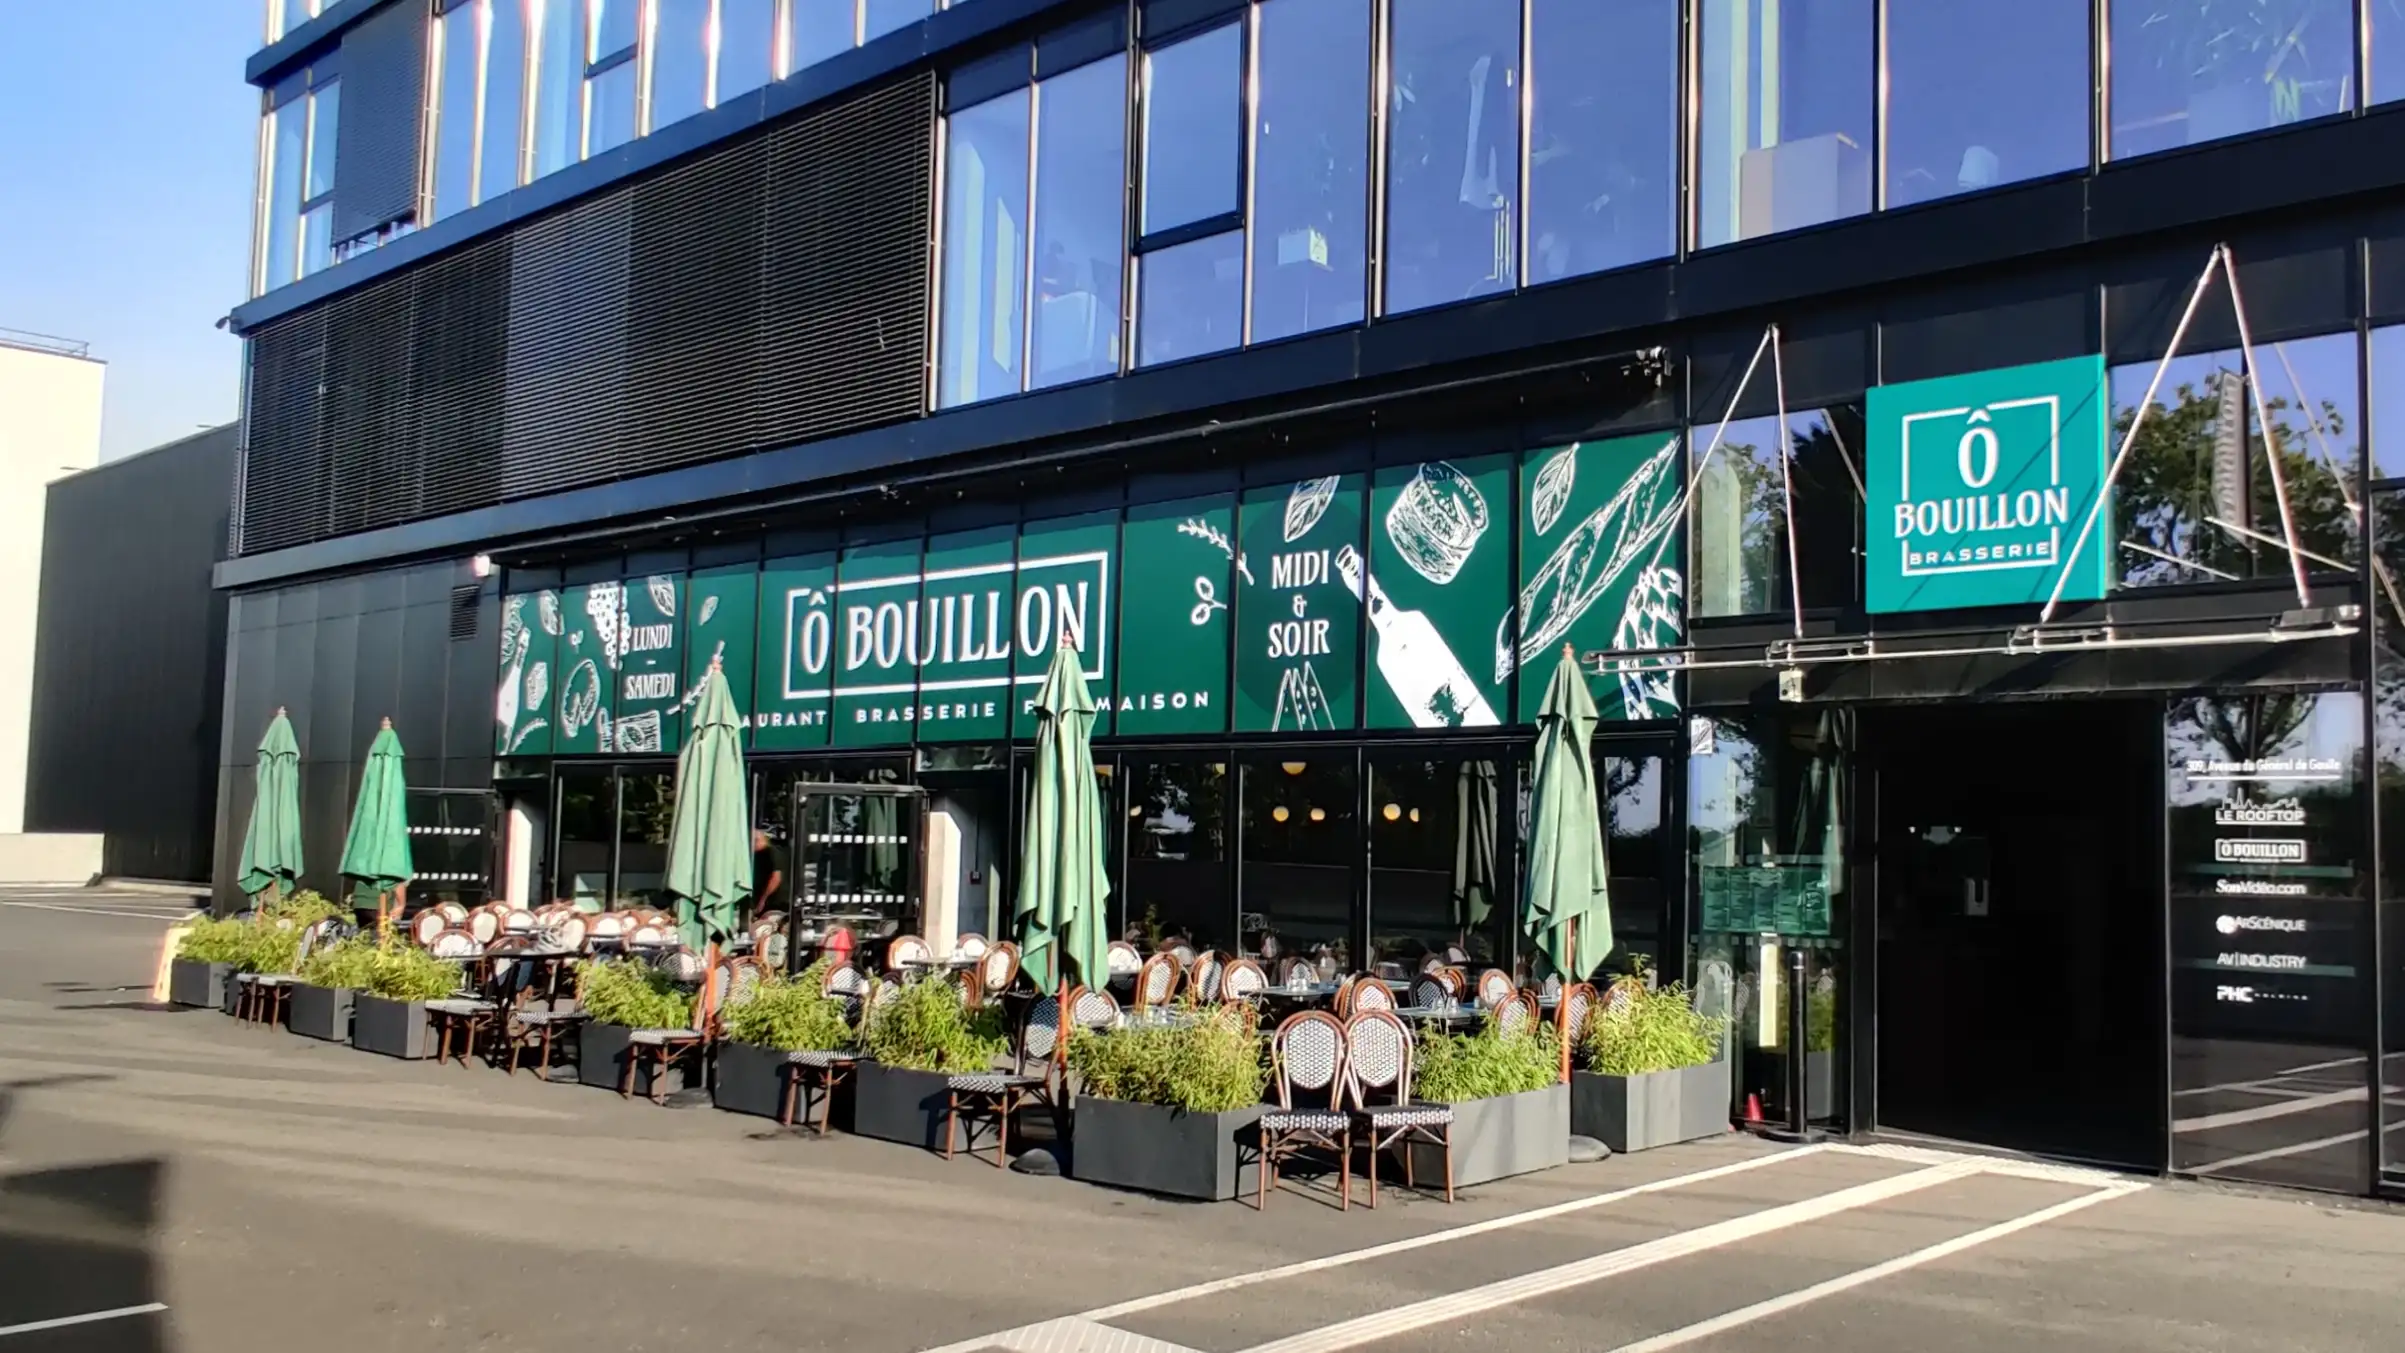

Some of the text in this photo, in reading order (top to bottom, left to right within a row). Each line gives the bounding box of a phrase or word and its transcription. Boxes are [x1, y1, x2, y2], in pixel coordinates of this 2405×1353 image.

[1957, 408, 1999, 489] Ô
[1894, 486, 2069, 539] BOUILLON
[1909, 541, 2050, 566] BRASSERIE
[1271, 550, 1330, 590] MIDI
[1292, 594, 1308, 618] &
[632, 624, 674, 652] LUNDI
[802, 581, 1089, 674] Ô BOUILLON
[1267, 619, 1331, 659] SOIR
[625, 673, 676, 700] SAMEDI
[740, 691, 1209, 728] AURANT BRASSERIE MAISON
[2215, 810, 2305, 822] LE ROOFTOP
[2233, 843, 2300, 857] BOUILLON
[2216, 985, 2254, 1003] PHC
